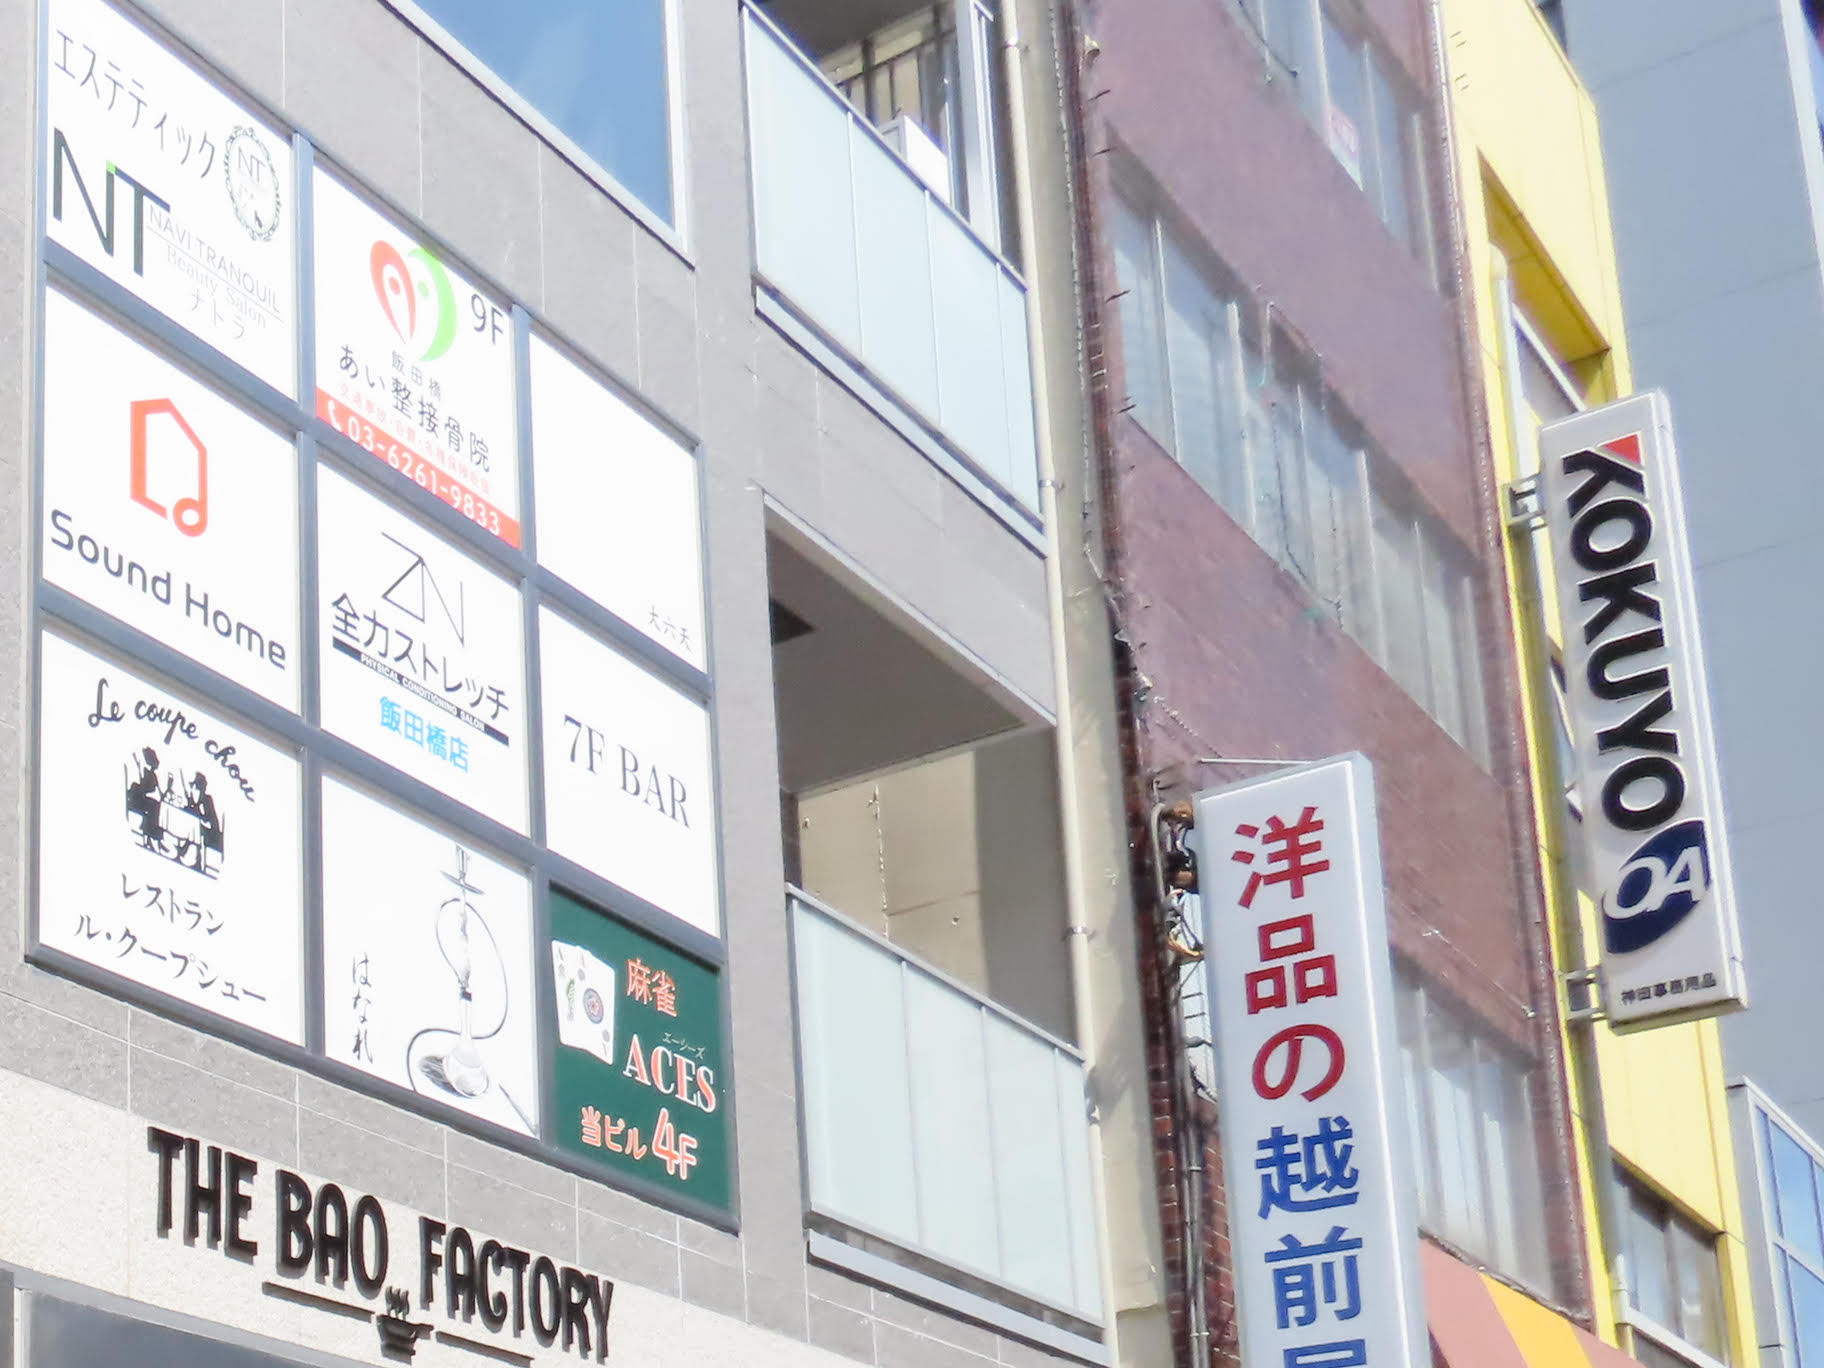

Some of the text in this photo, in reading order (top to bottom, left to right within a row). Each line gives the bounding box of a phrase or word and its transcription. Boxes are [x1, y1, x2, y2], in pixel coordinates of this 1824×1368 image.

[53, 29, 216, 179] エステティック
[53, 127, 171, 278] NT
[150, 204, 281, 314] NAVI TRANQUIL
[470, 293, 504, 345] 9F
[339, 344, 490, 473] あい整接骨院
[348, 416, 500, 535] 03-6261-9833
[51, 509, 286, 670] Sound Home
[1561, 433, 1687, 833] KOKUYO
[332, 593, 509, 720] 全力ストレッチ
[361, 653, 485, 732] PHYSICAL CONDITIONING SALON
[88, 678, 255, 803] Le coupe chou
[379, 696, 468, 773] 飯田橋店
[563, 714, 690, 829] 7F BAR
[74, 914, 267, 1003] ル・クープシュー
[121, 873, 225, 936] レストラン
[351, 951, 374, 1066] はなれ
[626, 957, 678, 1018] 麻雀
[622, 1033, 717, 1114] ACES
[662, 1032, 706, 1060] エーシーズ
[148, 1126, 615, 1365] THE BAO FACTORY
